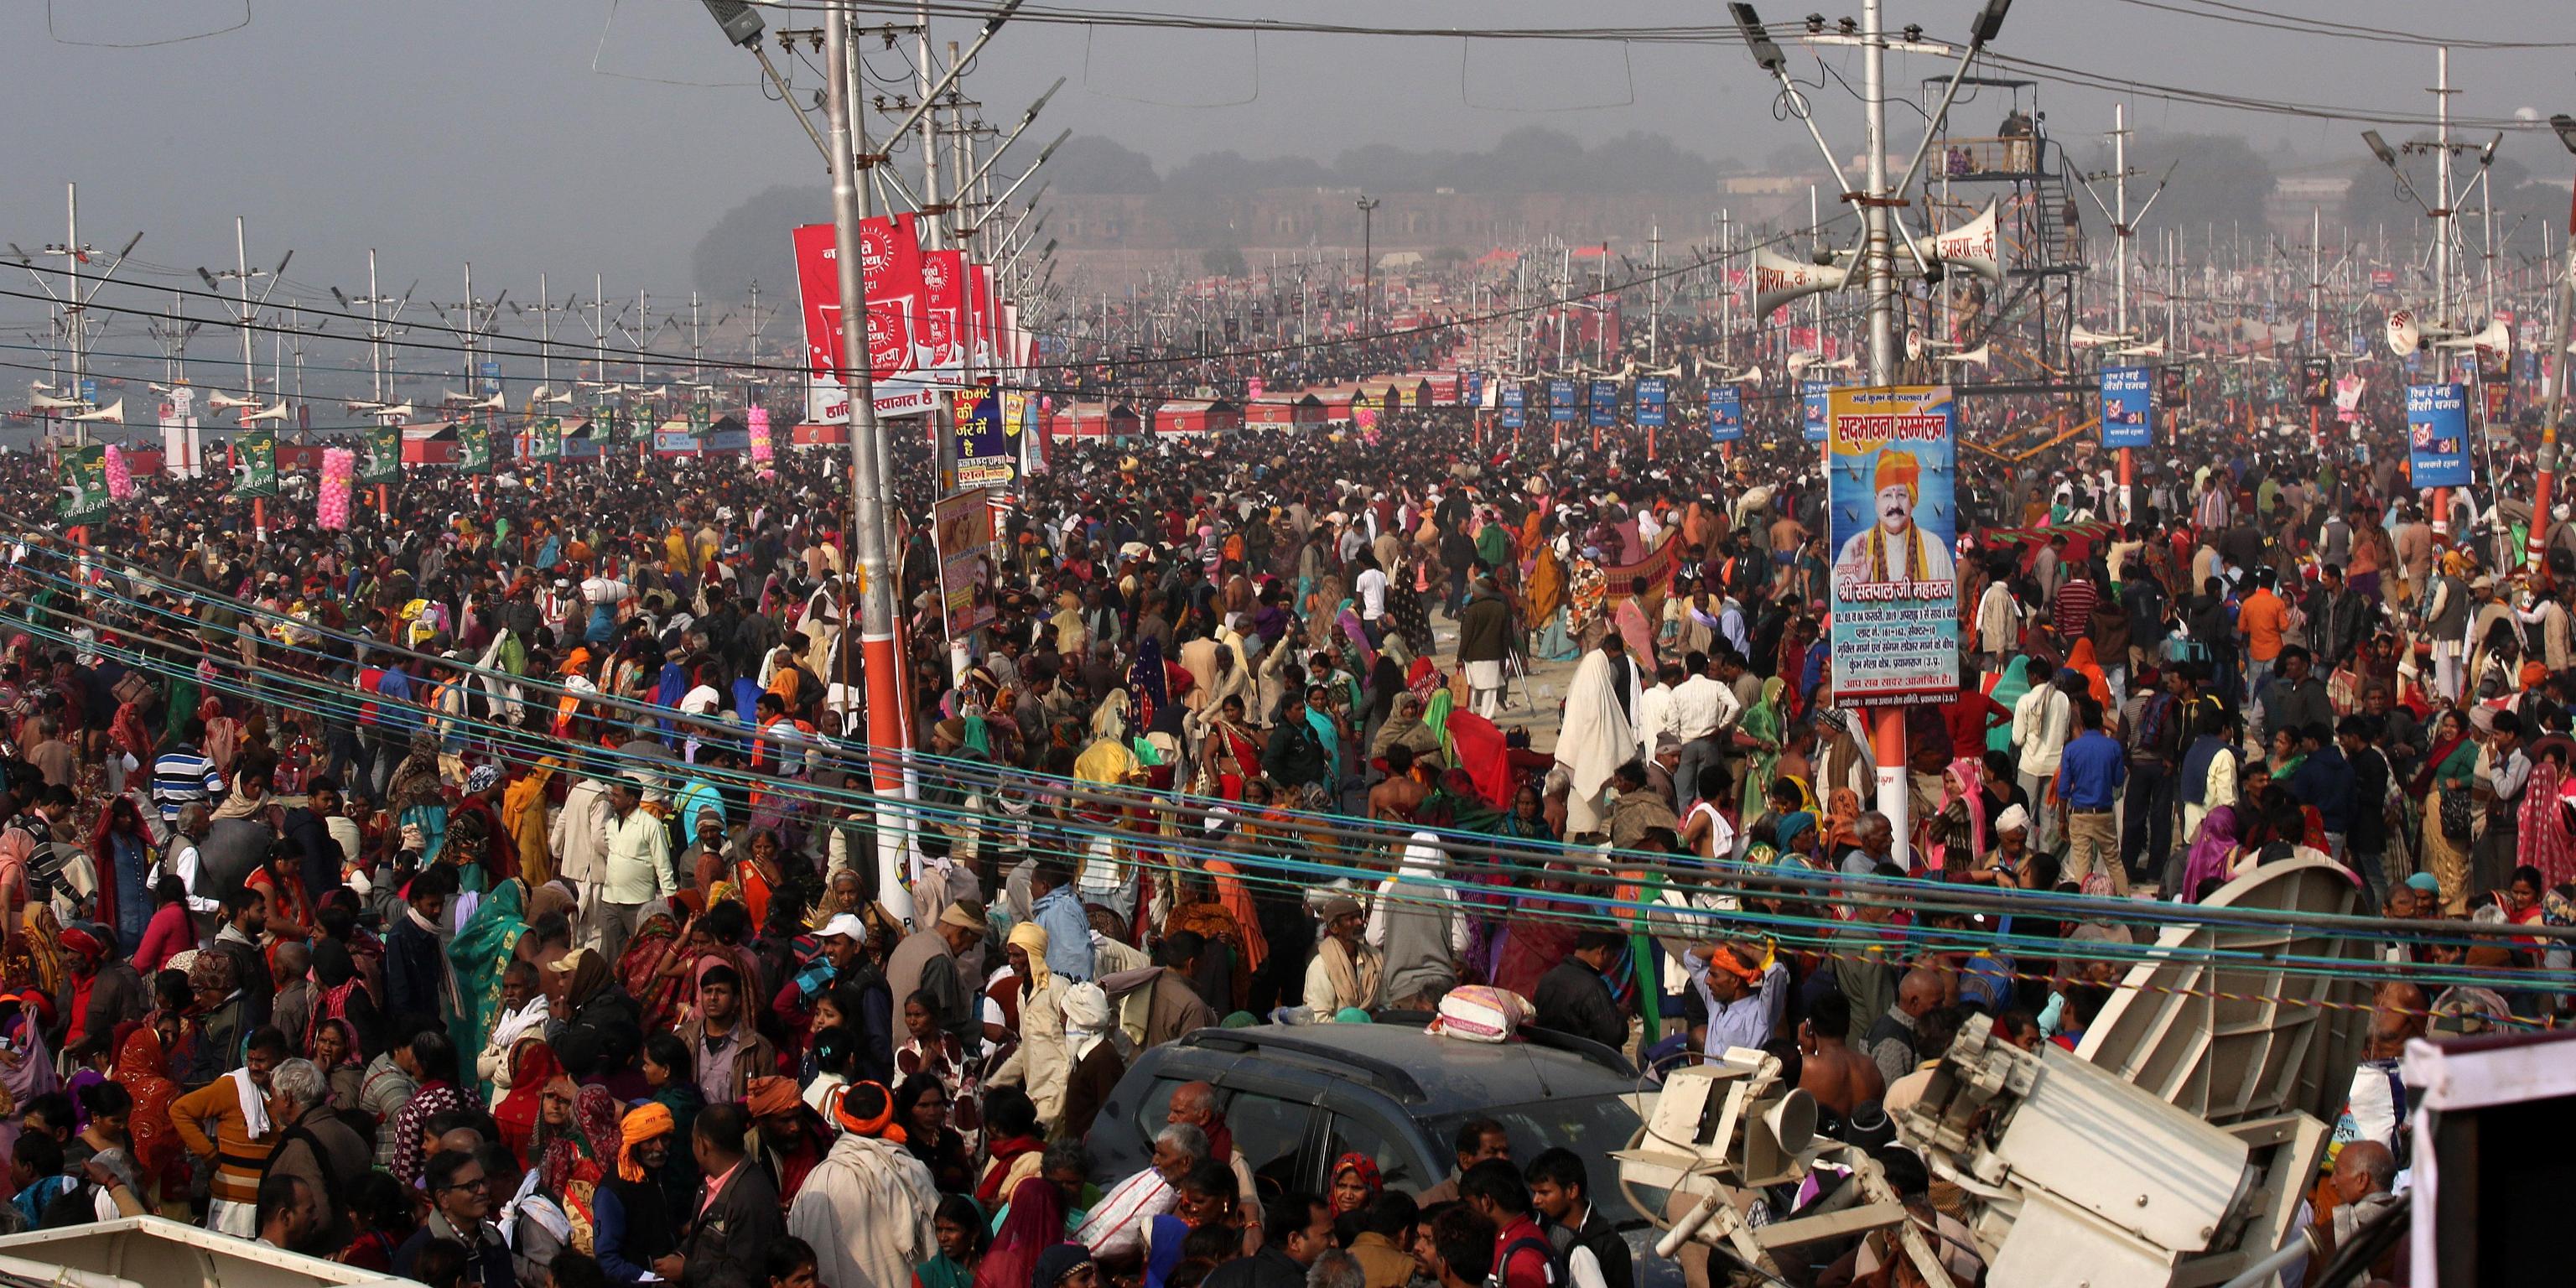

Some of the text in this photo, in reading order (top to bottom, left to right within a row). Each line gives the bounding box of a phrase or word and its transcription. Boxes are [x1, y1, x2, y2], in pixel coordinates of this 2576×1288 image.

[1940, 237, 1972, 259] आशा
[922, 388, 932, 406] है
[2435, 399, 2460, 410] चमक
[956, 402, 973, 419] की
[975, 418, 987, 434] में
[1897, 406, 1947, 442] सम्मेलन
[963, 439, 974, 456] है
[1838, 576, 1954, 602] श्री सतपाल जी महाराज
[1886, 610, 1897, 621] 2019
[1924, 605, 1929, 620] से
[1856, 639, 1870, 653] मार्ग
[1871, 638, 1881, 653] एवं
[1882, 639, 1899, 653] संगम
[1900, 638, 1918, 652] लोअर
[1919, 637, 1933, 652] मार्ग
[1934, 637, 1941, 650] के
[1942, 636, 1955, 649] बीच
[1848, 658, 1862, 674] कुंभ
[1862, 657, 1877, 669] मेला
[1893, 658, 1922, 668] प्रयागराज
[1844, 679, 1861, 688] आप
[1864, 678, 1878, 688] सब
[1881, 678, 1903, 687] सादर
[1905, 674, 1939, 686] आमंत्रित
